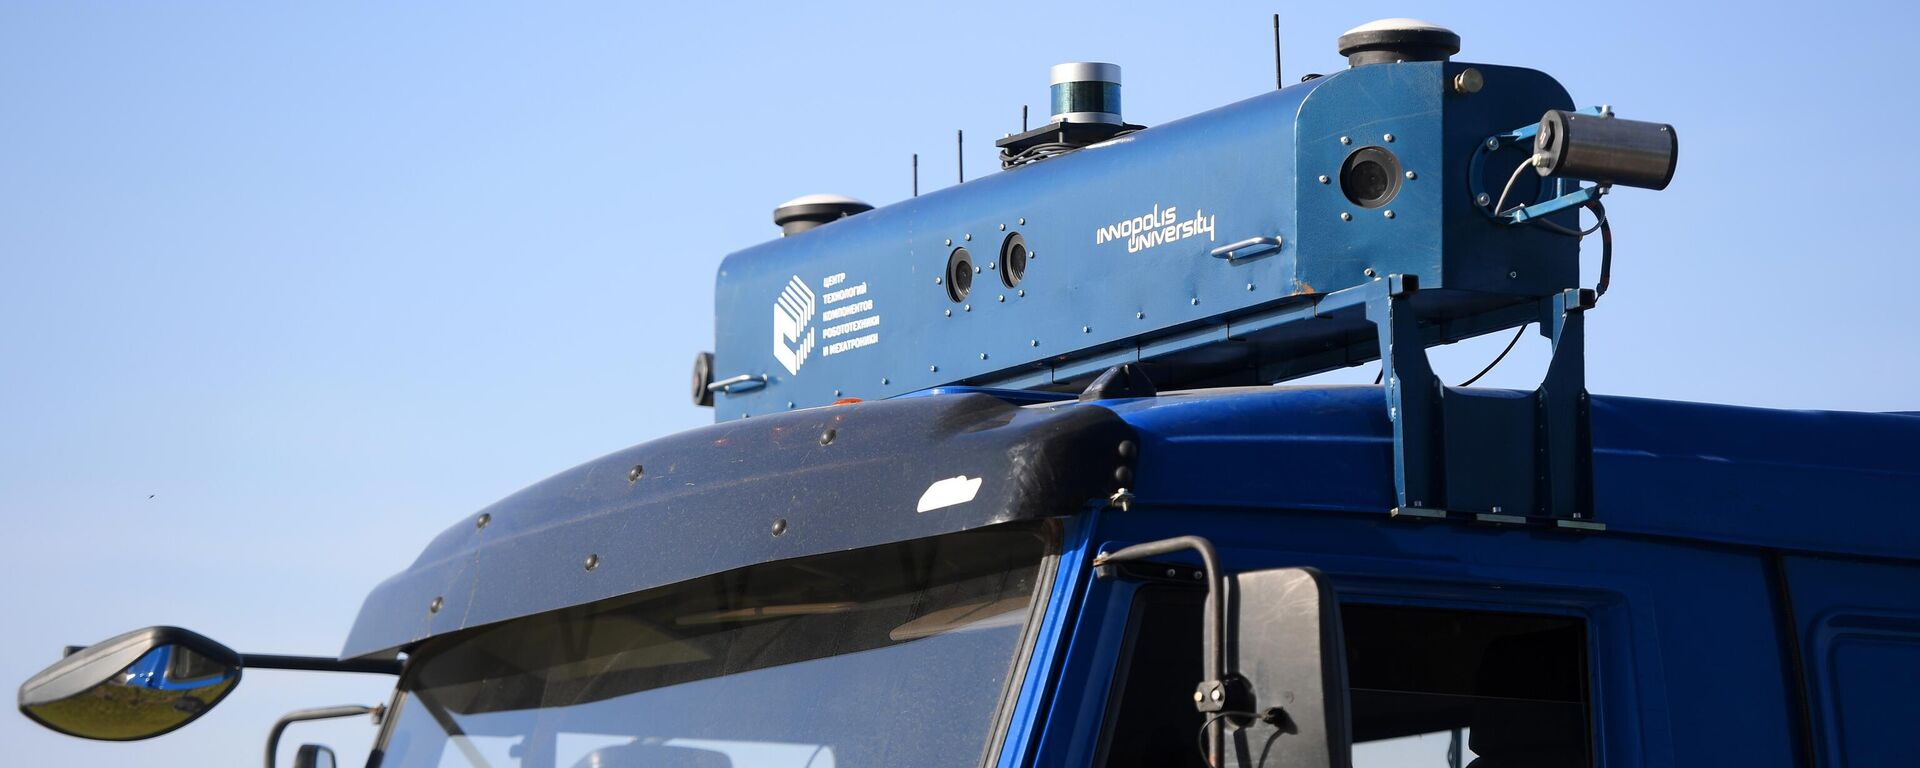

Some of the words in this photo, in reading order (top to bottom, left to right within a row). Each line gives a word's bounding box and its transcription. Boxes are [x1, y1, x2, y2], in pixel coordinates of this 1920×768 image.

[823, 272, 846, 289] ЦЕНТР
[822, 281, 867, 305] ТЕХНОЛОГИЙ
[822, 299, 873, 322] КОМПОНЕНТОВ
[822, 315, 880, 339] РОБОТОТЕХНИКИ
[822, 345, 829, 357] И
[829, 333, 879, 355] МЕХАТРОНИКИ
